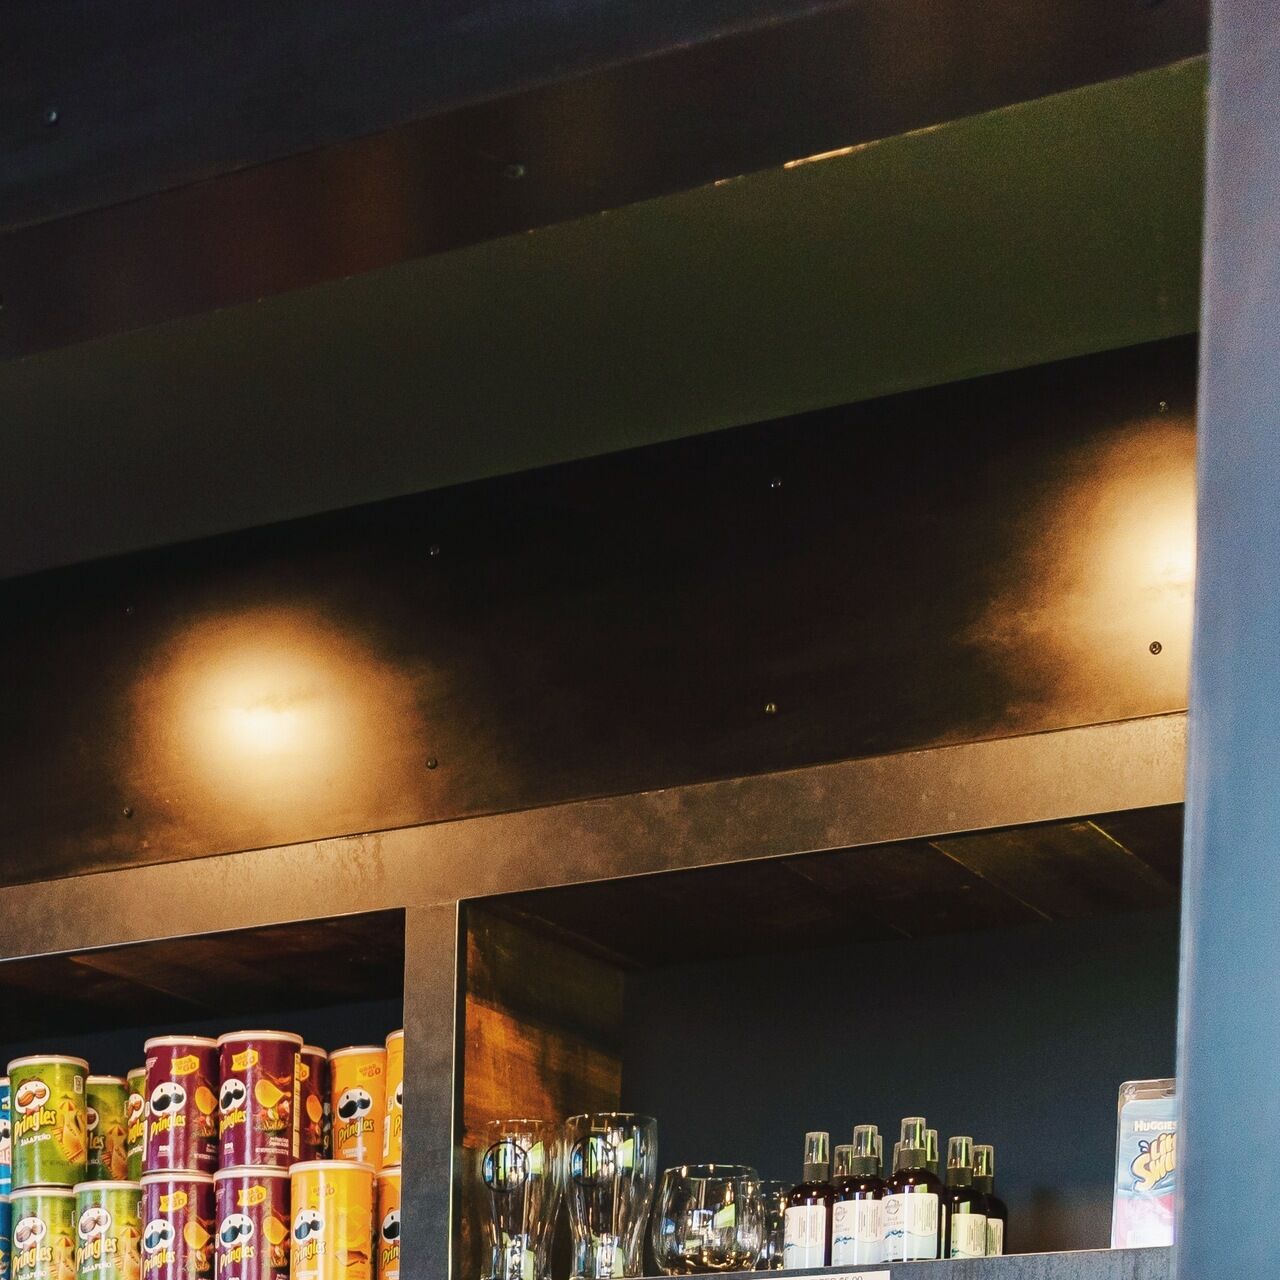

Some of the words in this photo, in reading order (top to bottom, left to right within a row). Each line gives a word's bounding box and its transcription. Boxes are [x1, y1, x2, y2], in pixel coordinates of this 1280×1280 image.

[14, 1106, 56, 1145] Pringles
[150, 1113, 186, 1142] Pringles
[338, 1118, 374, 1148] Pringles
[220, 1245, 254, 1272] Pringles
